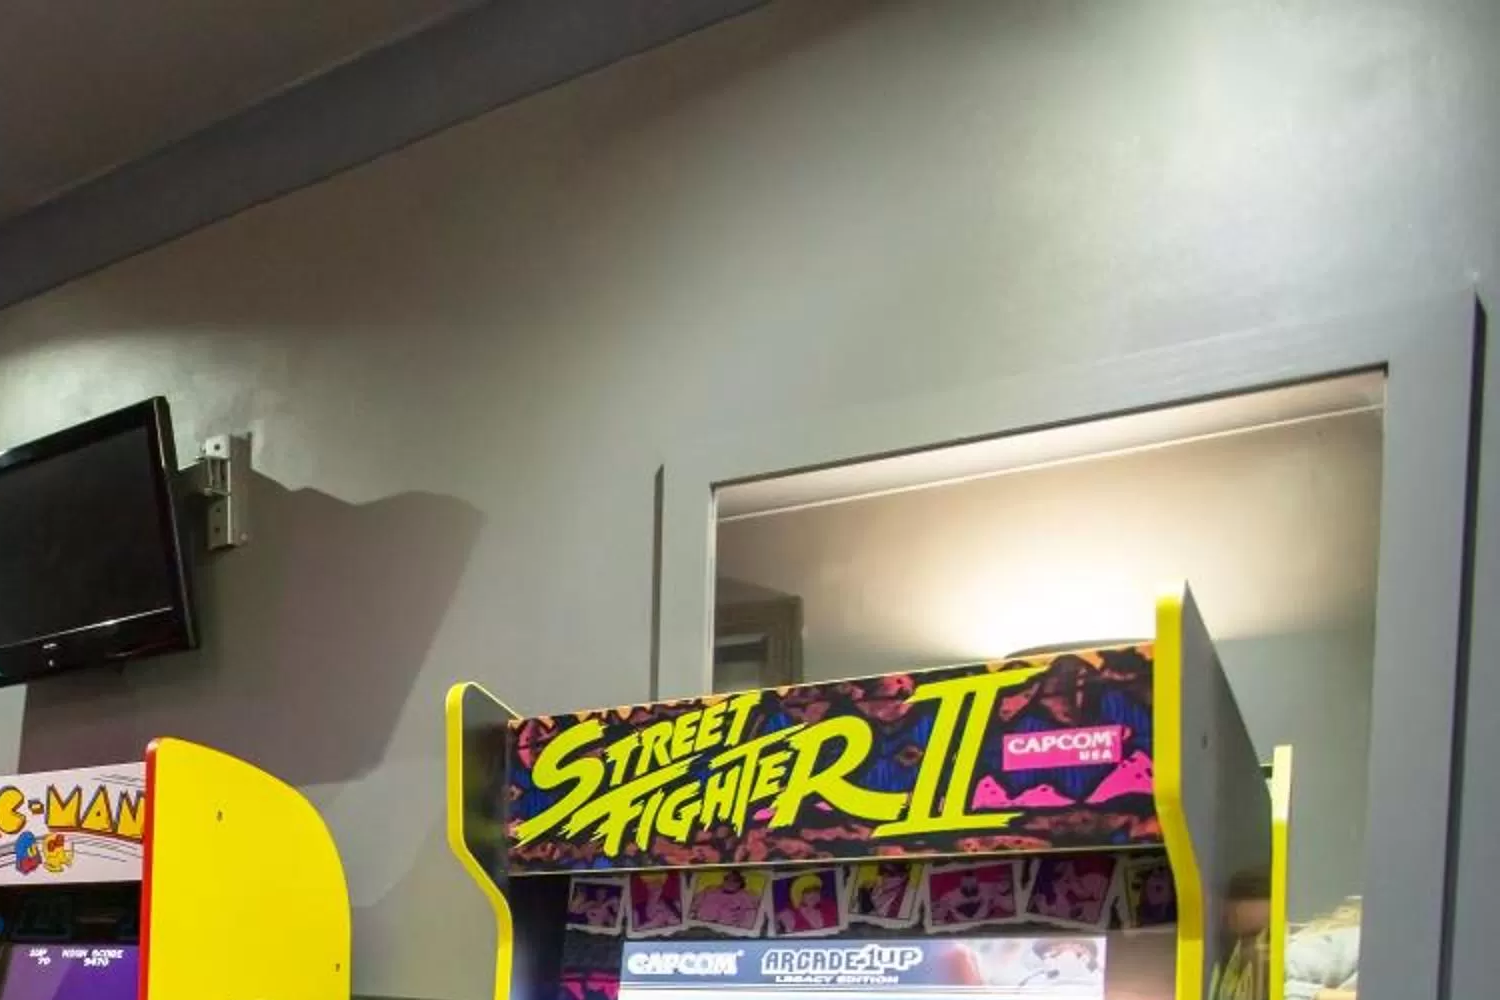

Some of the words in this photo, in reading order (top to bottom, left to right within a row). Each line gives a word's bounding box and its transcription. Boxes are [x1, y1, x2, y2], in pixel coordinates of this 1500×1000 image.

[1008, 731, 1113, 754] CAPCOM
[556, 716, 910, 858] FIGHTER
[872, 666, 1054, 838] II
[1078, 750, 1113, 761] USA
[513, 689, 762, 848] STREET
[628, 952, 737, 975] CAPCOM
